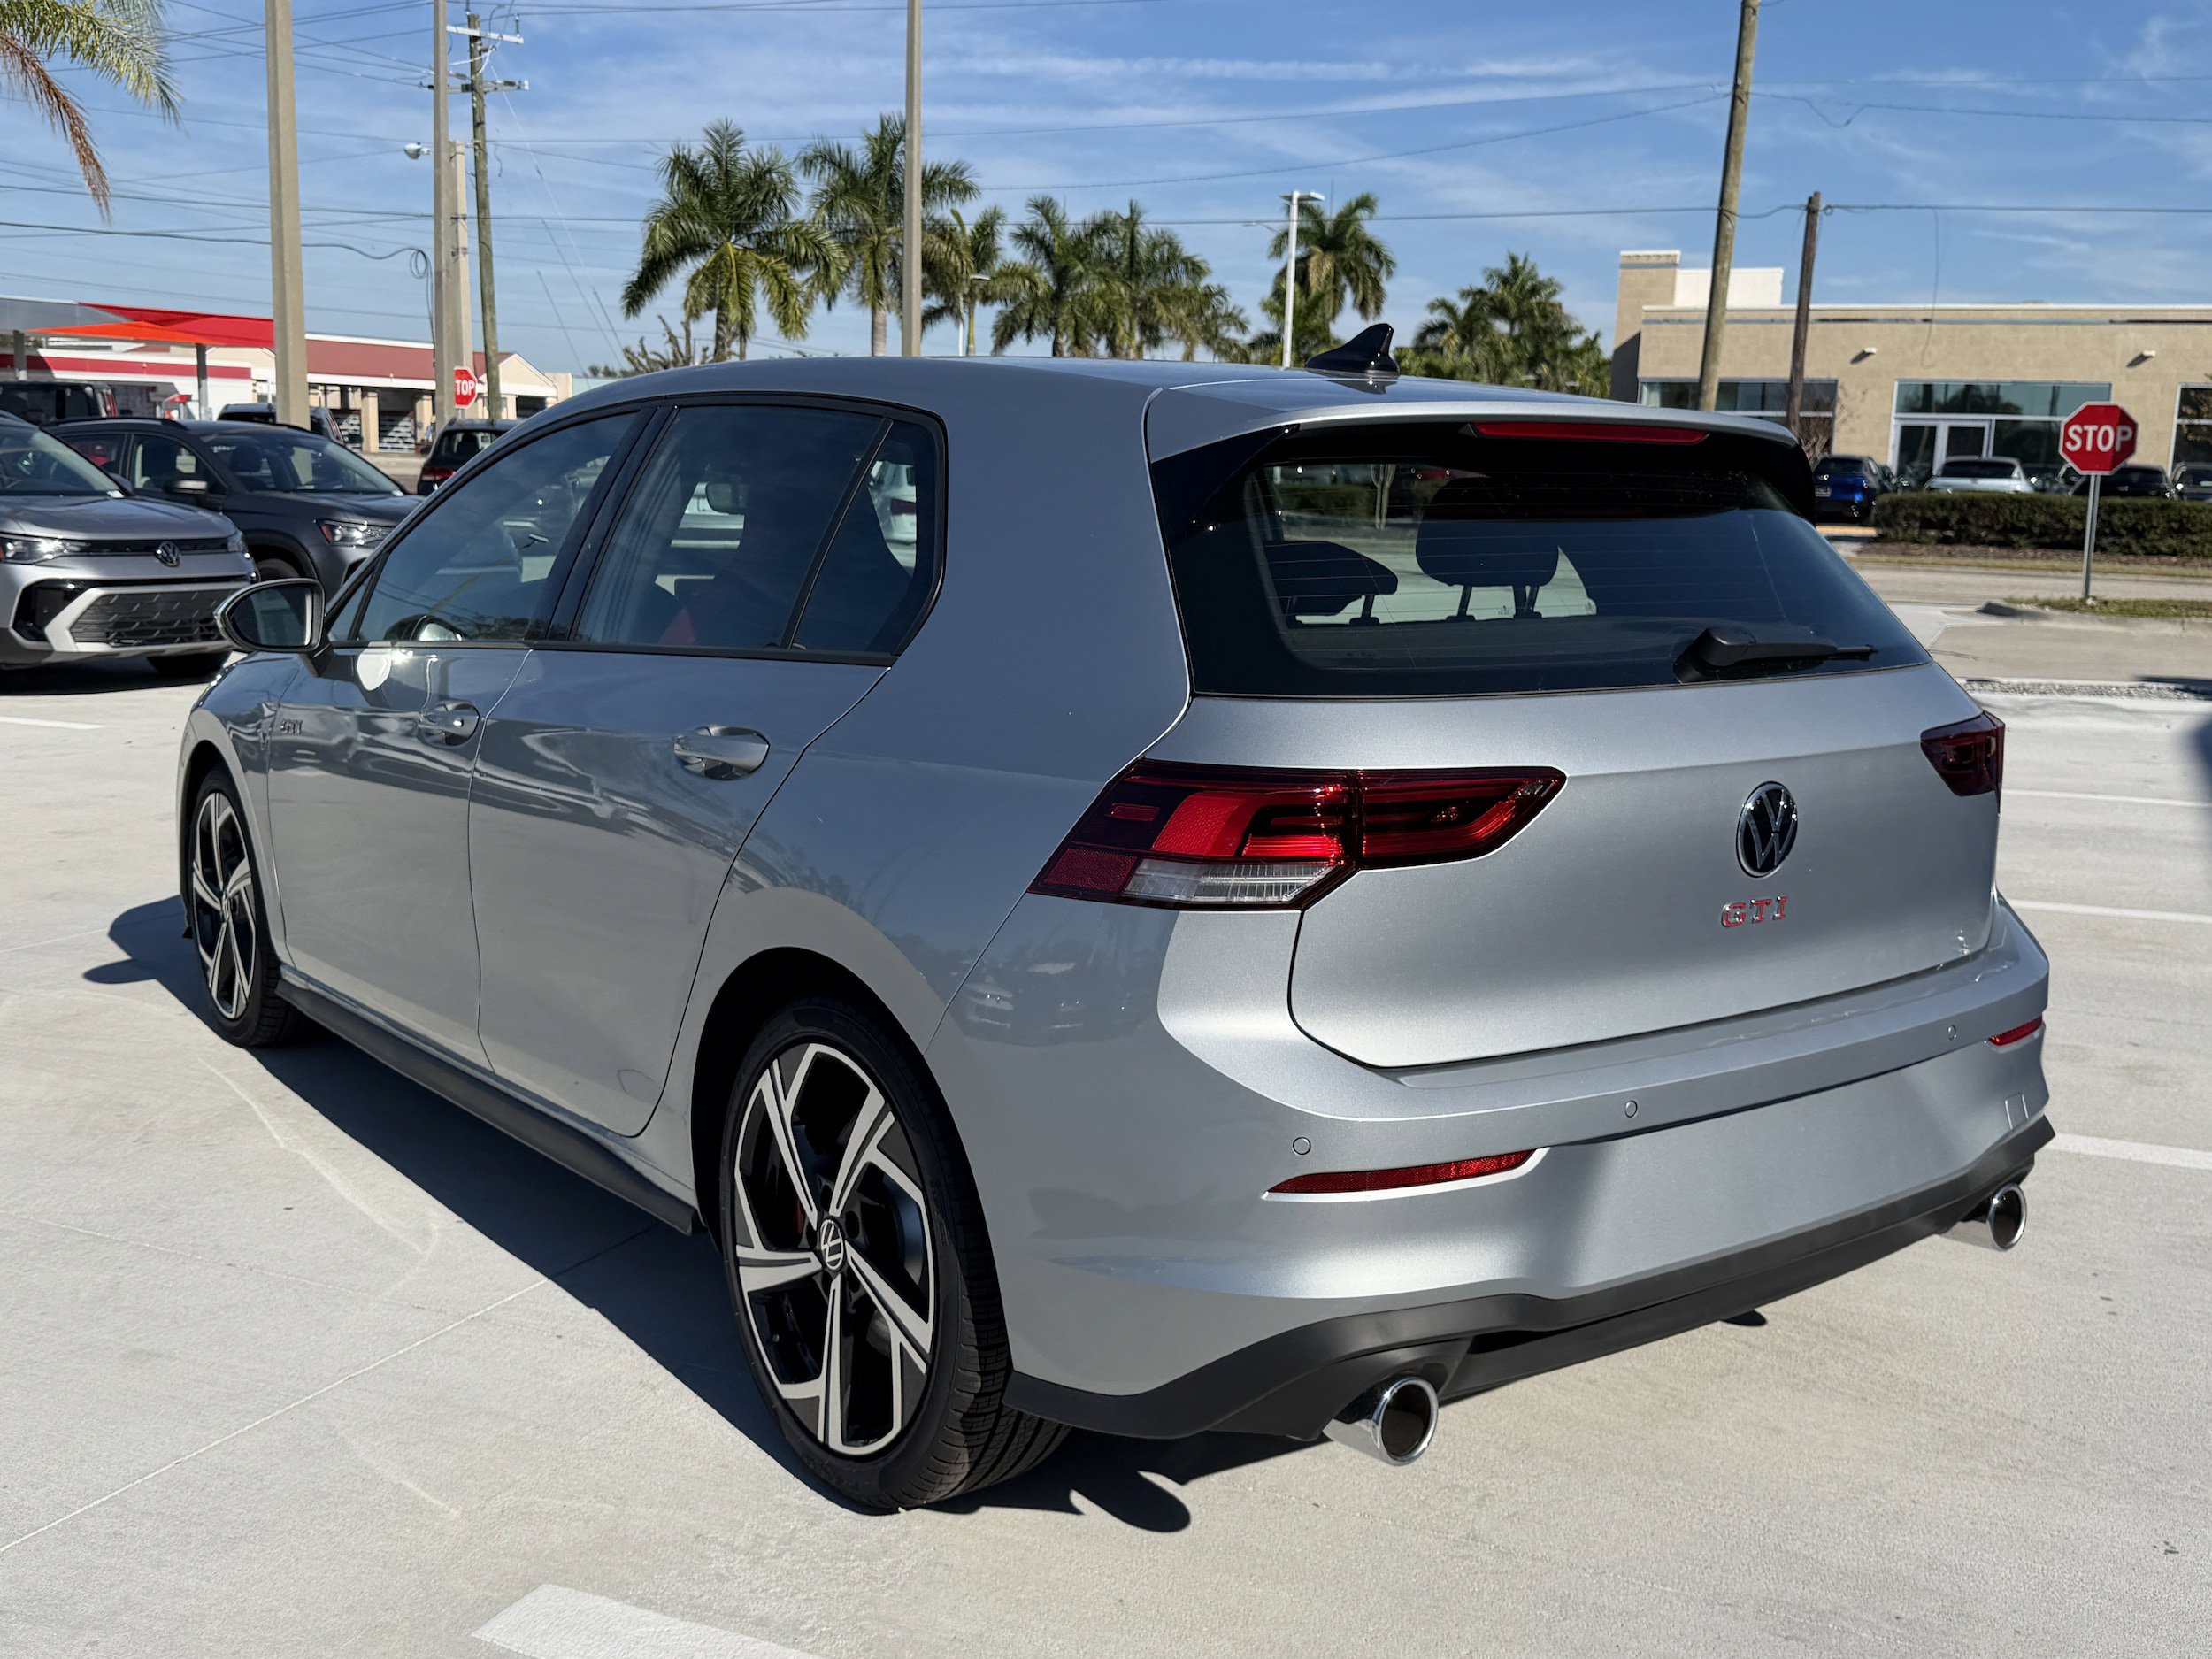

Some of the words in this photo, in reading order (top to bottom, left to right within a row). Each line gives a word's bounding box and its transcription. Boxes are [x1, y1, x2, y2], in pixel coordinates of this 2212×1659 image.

[454, 380, 475, 396] TOP
[2064, 424, 2133, 453] STOP
[1721, 895, 1788, 927] GTI
